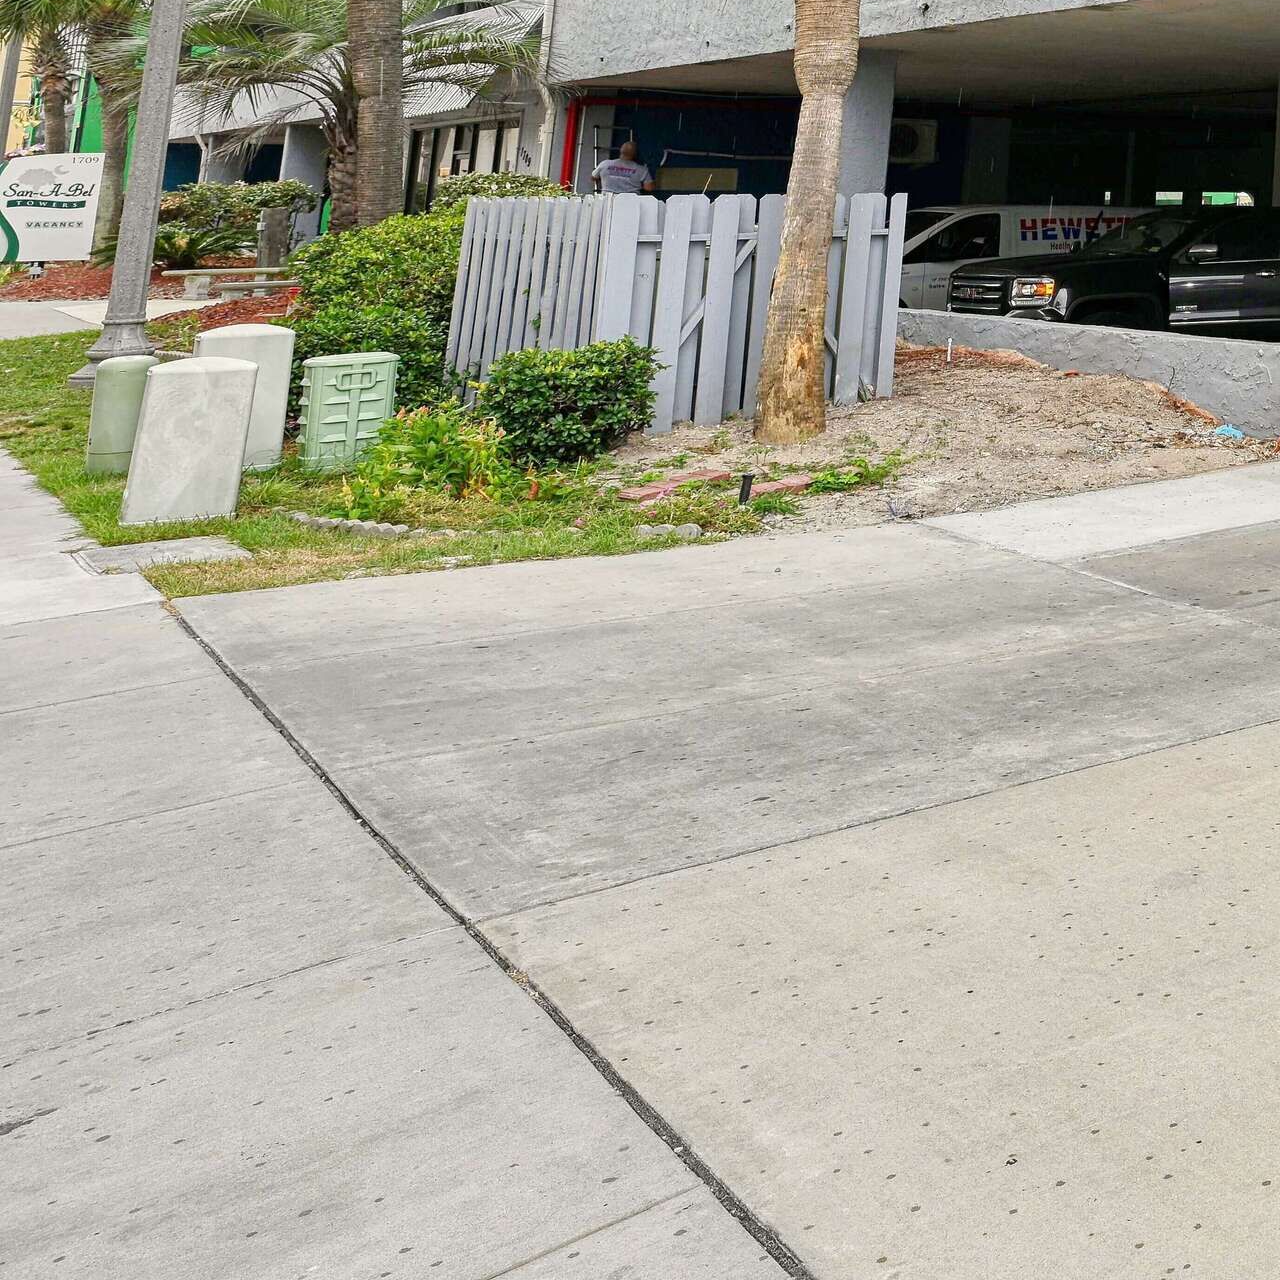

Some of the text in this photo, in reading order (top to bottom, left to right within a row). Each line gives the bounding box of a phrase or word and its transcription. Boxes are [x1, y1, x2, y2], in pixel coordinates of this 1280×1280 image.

[72, 156, 100, 164] 1709
[3, 183, 95, 198] San-A-Bel
[16, 200, 78, 208] TOWERS
